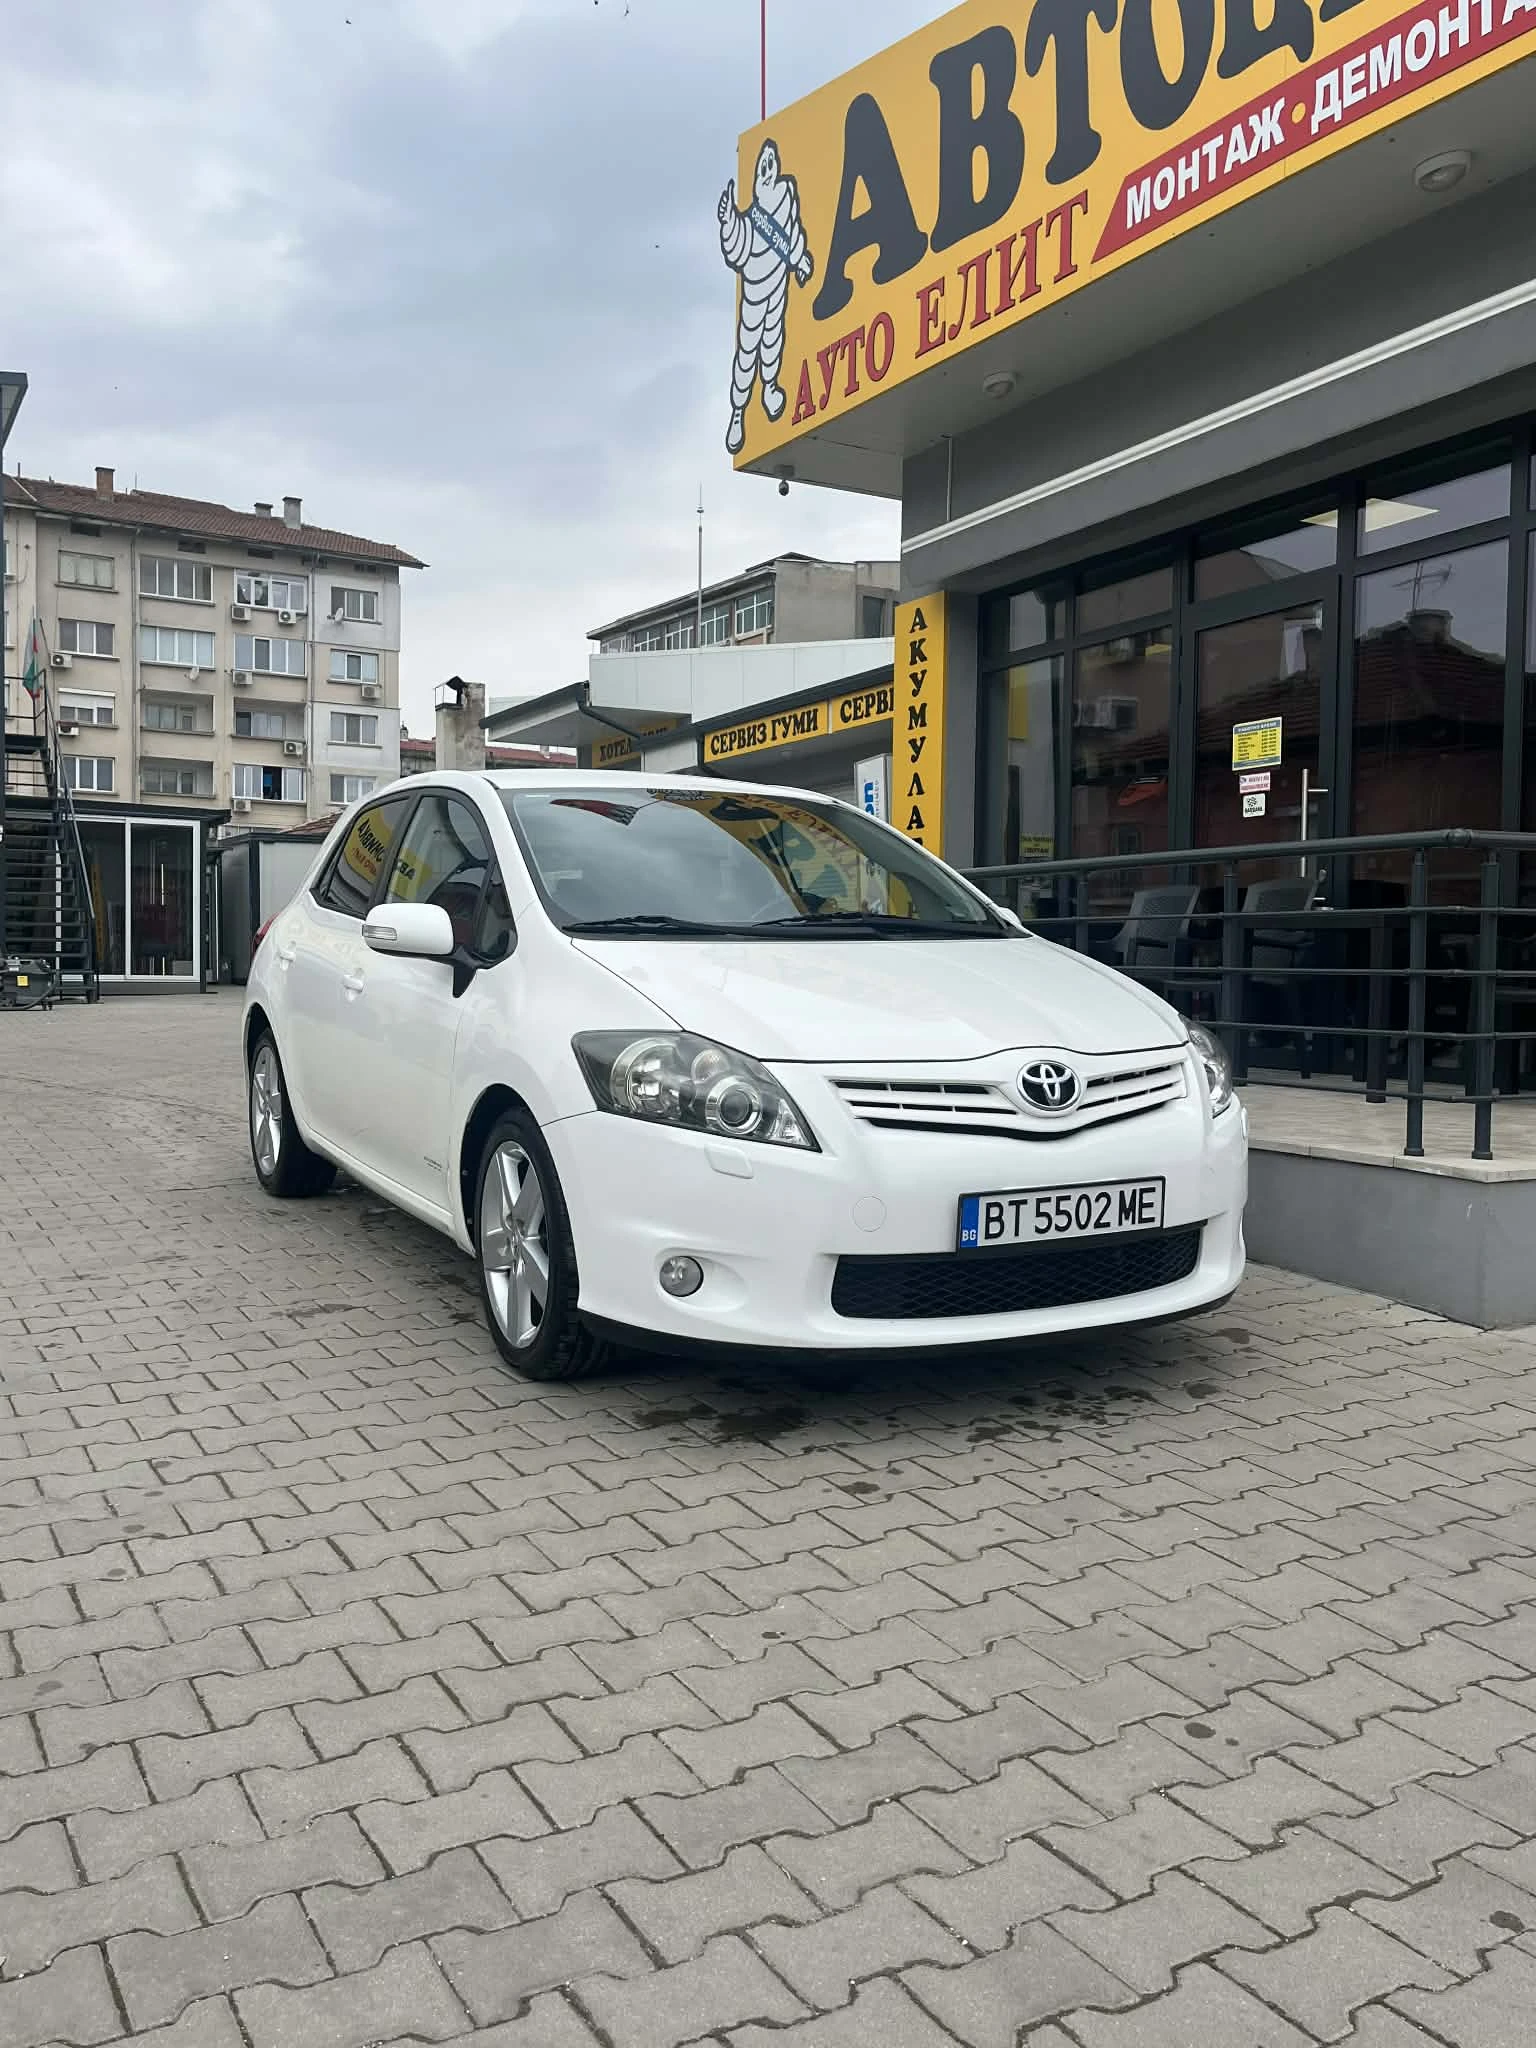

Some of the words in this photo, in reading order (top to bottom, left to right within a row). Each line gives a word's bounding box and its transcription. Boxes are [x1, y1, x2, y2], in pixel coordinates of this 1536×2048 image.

[813, 0, 1367, 322] АВТО
[1126, 97, 1286, 229] МОНТАЖ
[792, 311, 895, 426] АУТО
[914, 189, 1089, 359] ЕЛИТ
[710, 722, 767, 756] СЕРВИЗ
[771, 708, 819, 742] ГУМИ
[961, 1229, 977, 1241] BG
